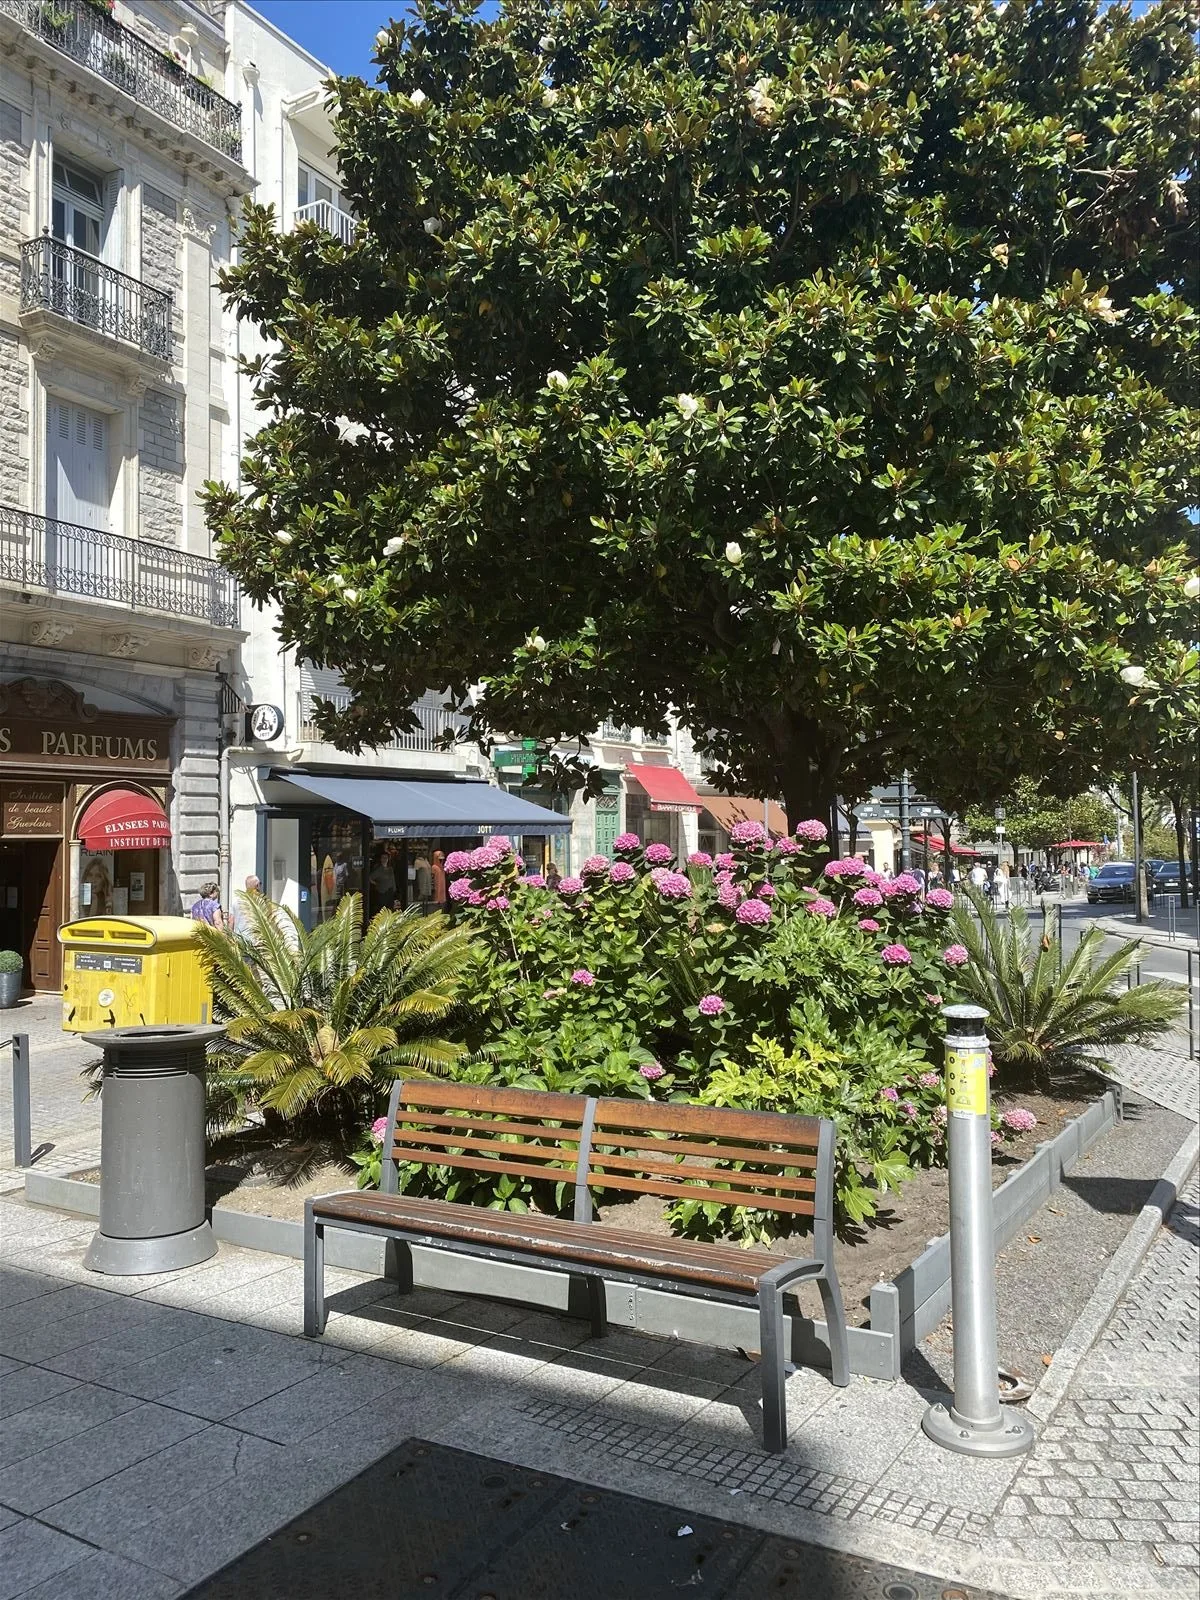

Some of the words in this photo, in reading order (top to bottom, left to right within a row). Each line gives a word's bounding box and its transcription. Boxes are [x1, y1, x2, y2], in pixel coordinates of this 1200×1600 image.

[40, 731, 157, 761] PARFUMS
[9, 789, 52, 800] Institut
[8, 803, 19, 813] de
[25, 803, 53, 814] beauté
[6, 815, 52, 829] Guerlain
[105, 819, 149, 834] ELYSEES
[477, 825, 492, 834] JOTT
[110, 838, 150, 847] INSTITUT
[152, 838, 161, 846] DE
